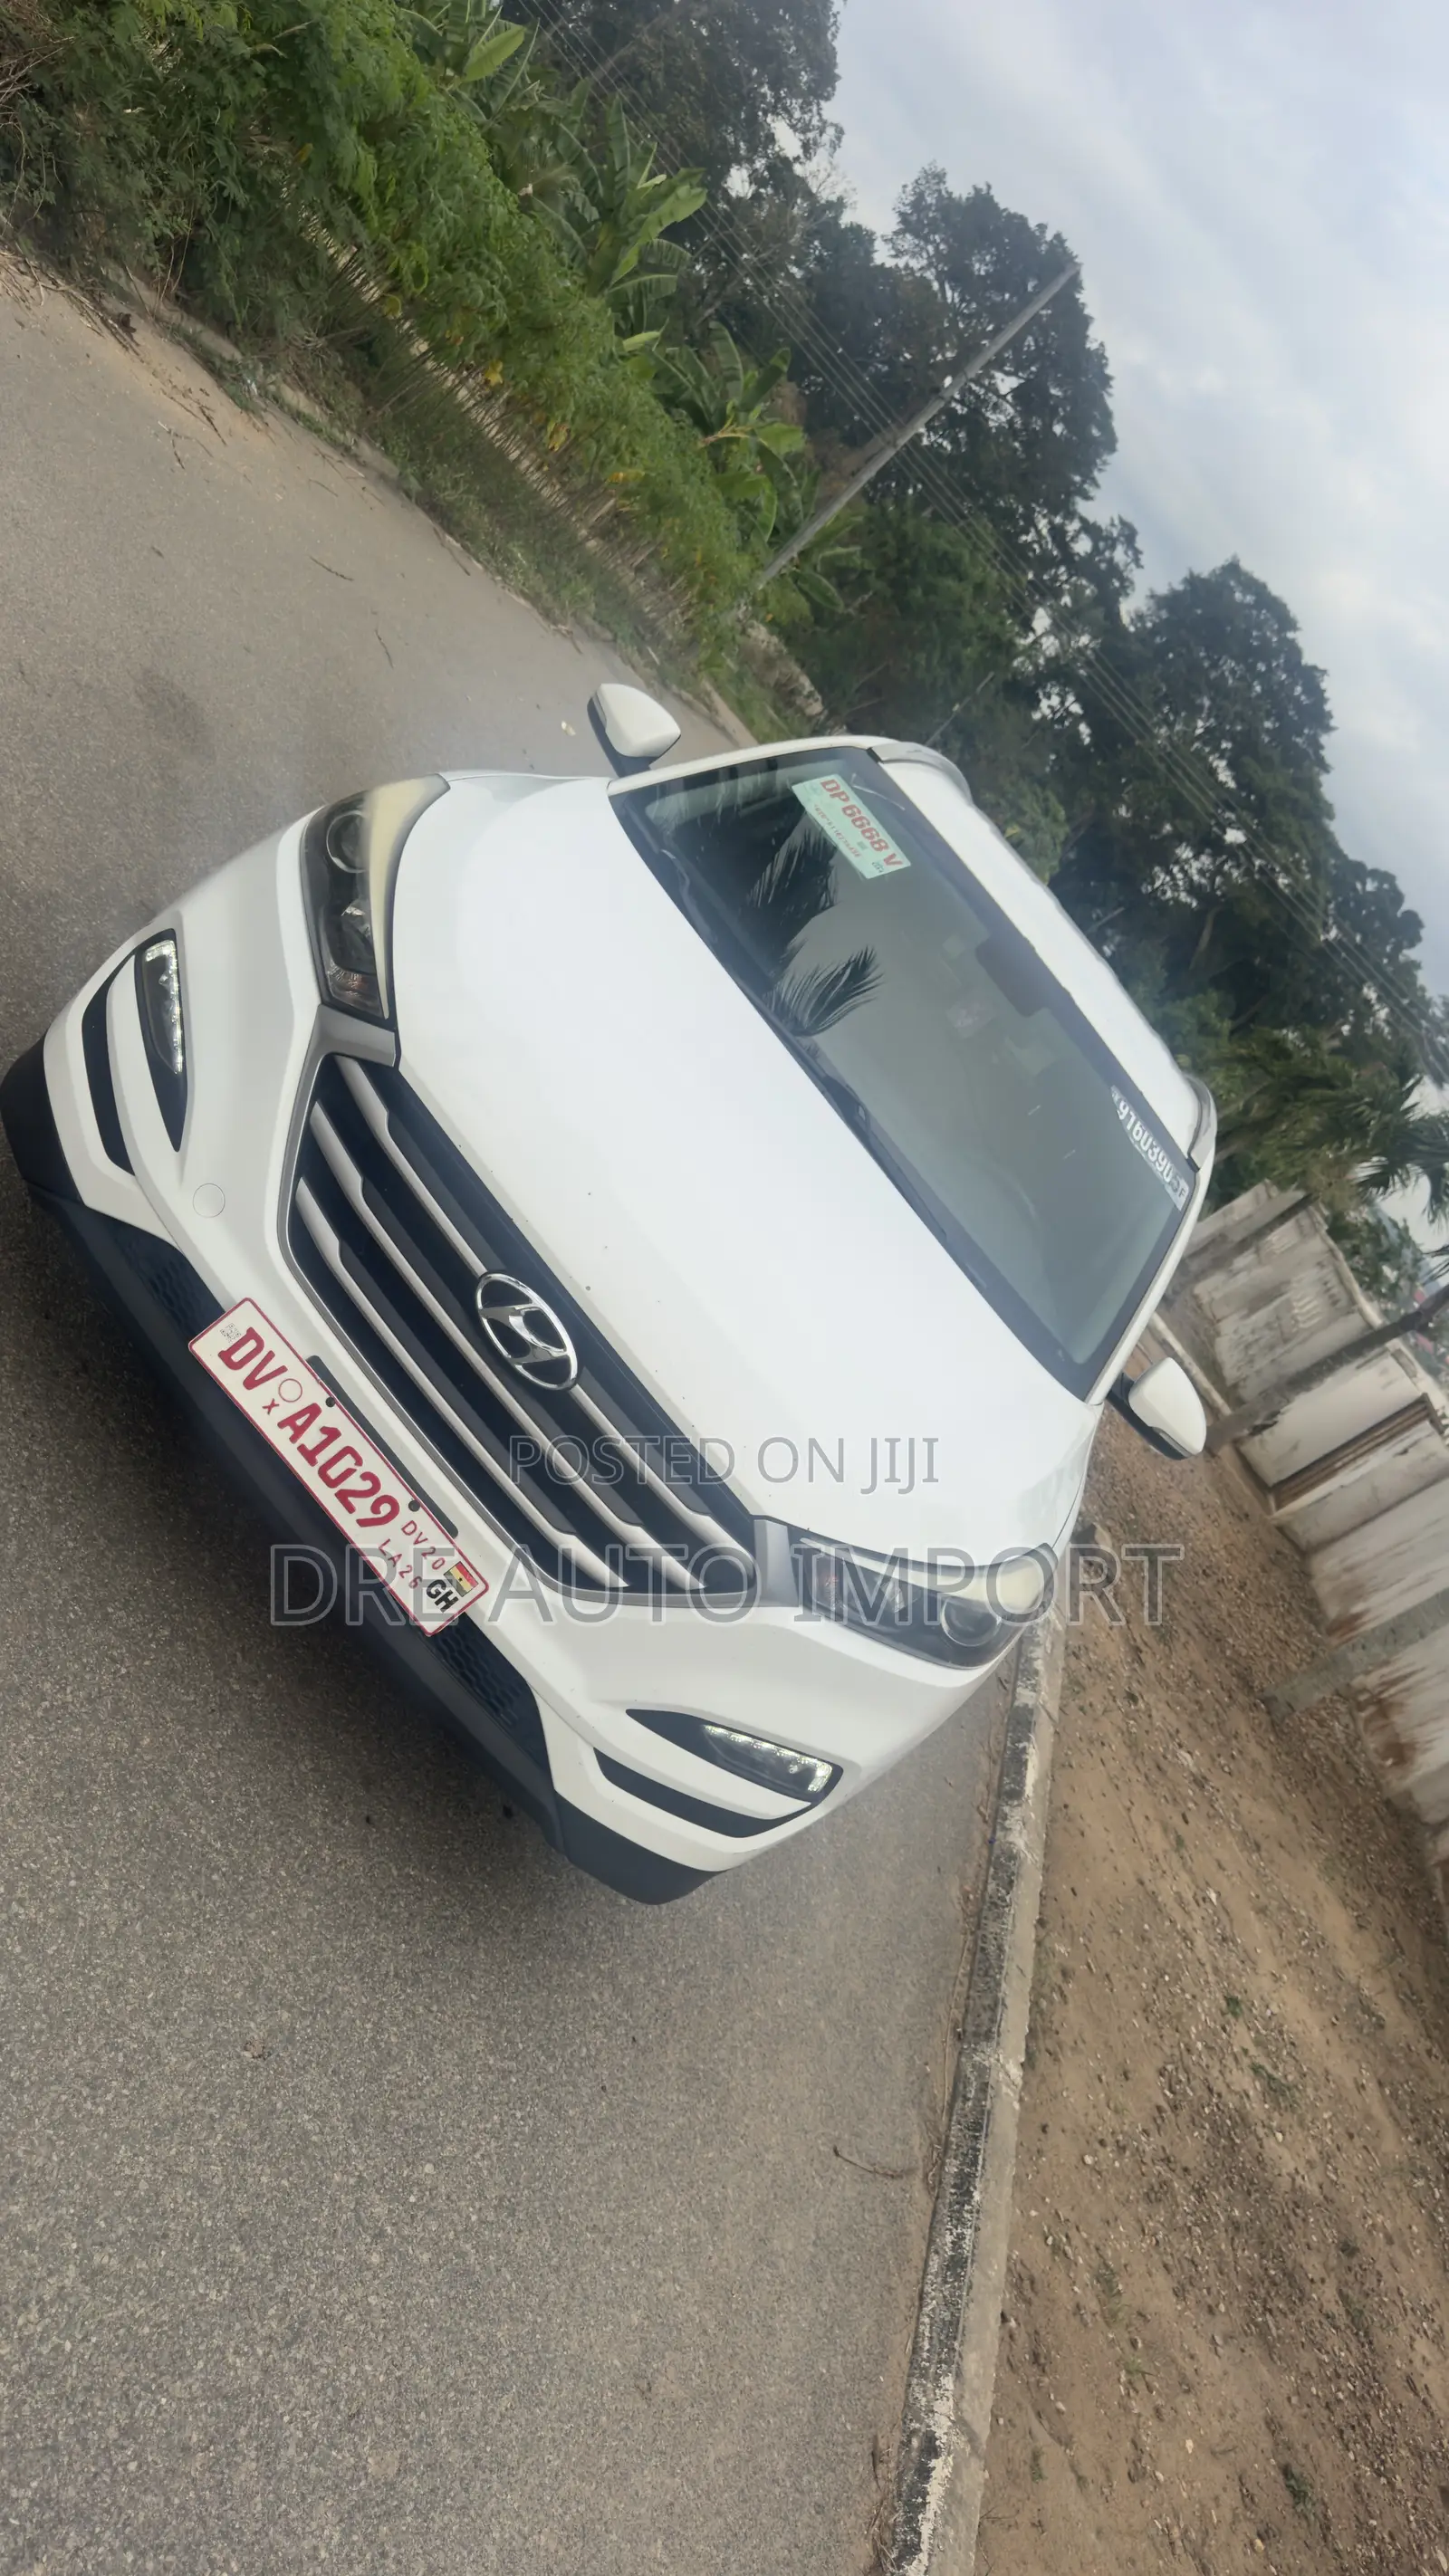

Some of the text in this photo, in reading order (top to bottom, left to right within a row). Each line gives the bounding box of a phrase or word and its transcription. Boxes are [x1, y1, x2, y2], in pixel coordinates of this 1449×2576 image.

[820, 779, 849, 803] DP
[883, 853, 904, 867] V
[218, 1326, 287, 1391] DV
[278, 1403, 400, 1528] A1029
[426, 1579, 458, 1614] GH
